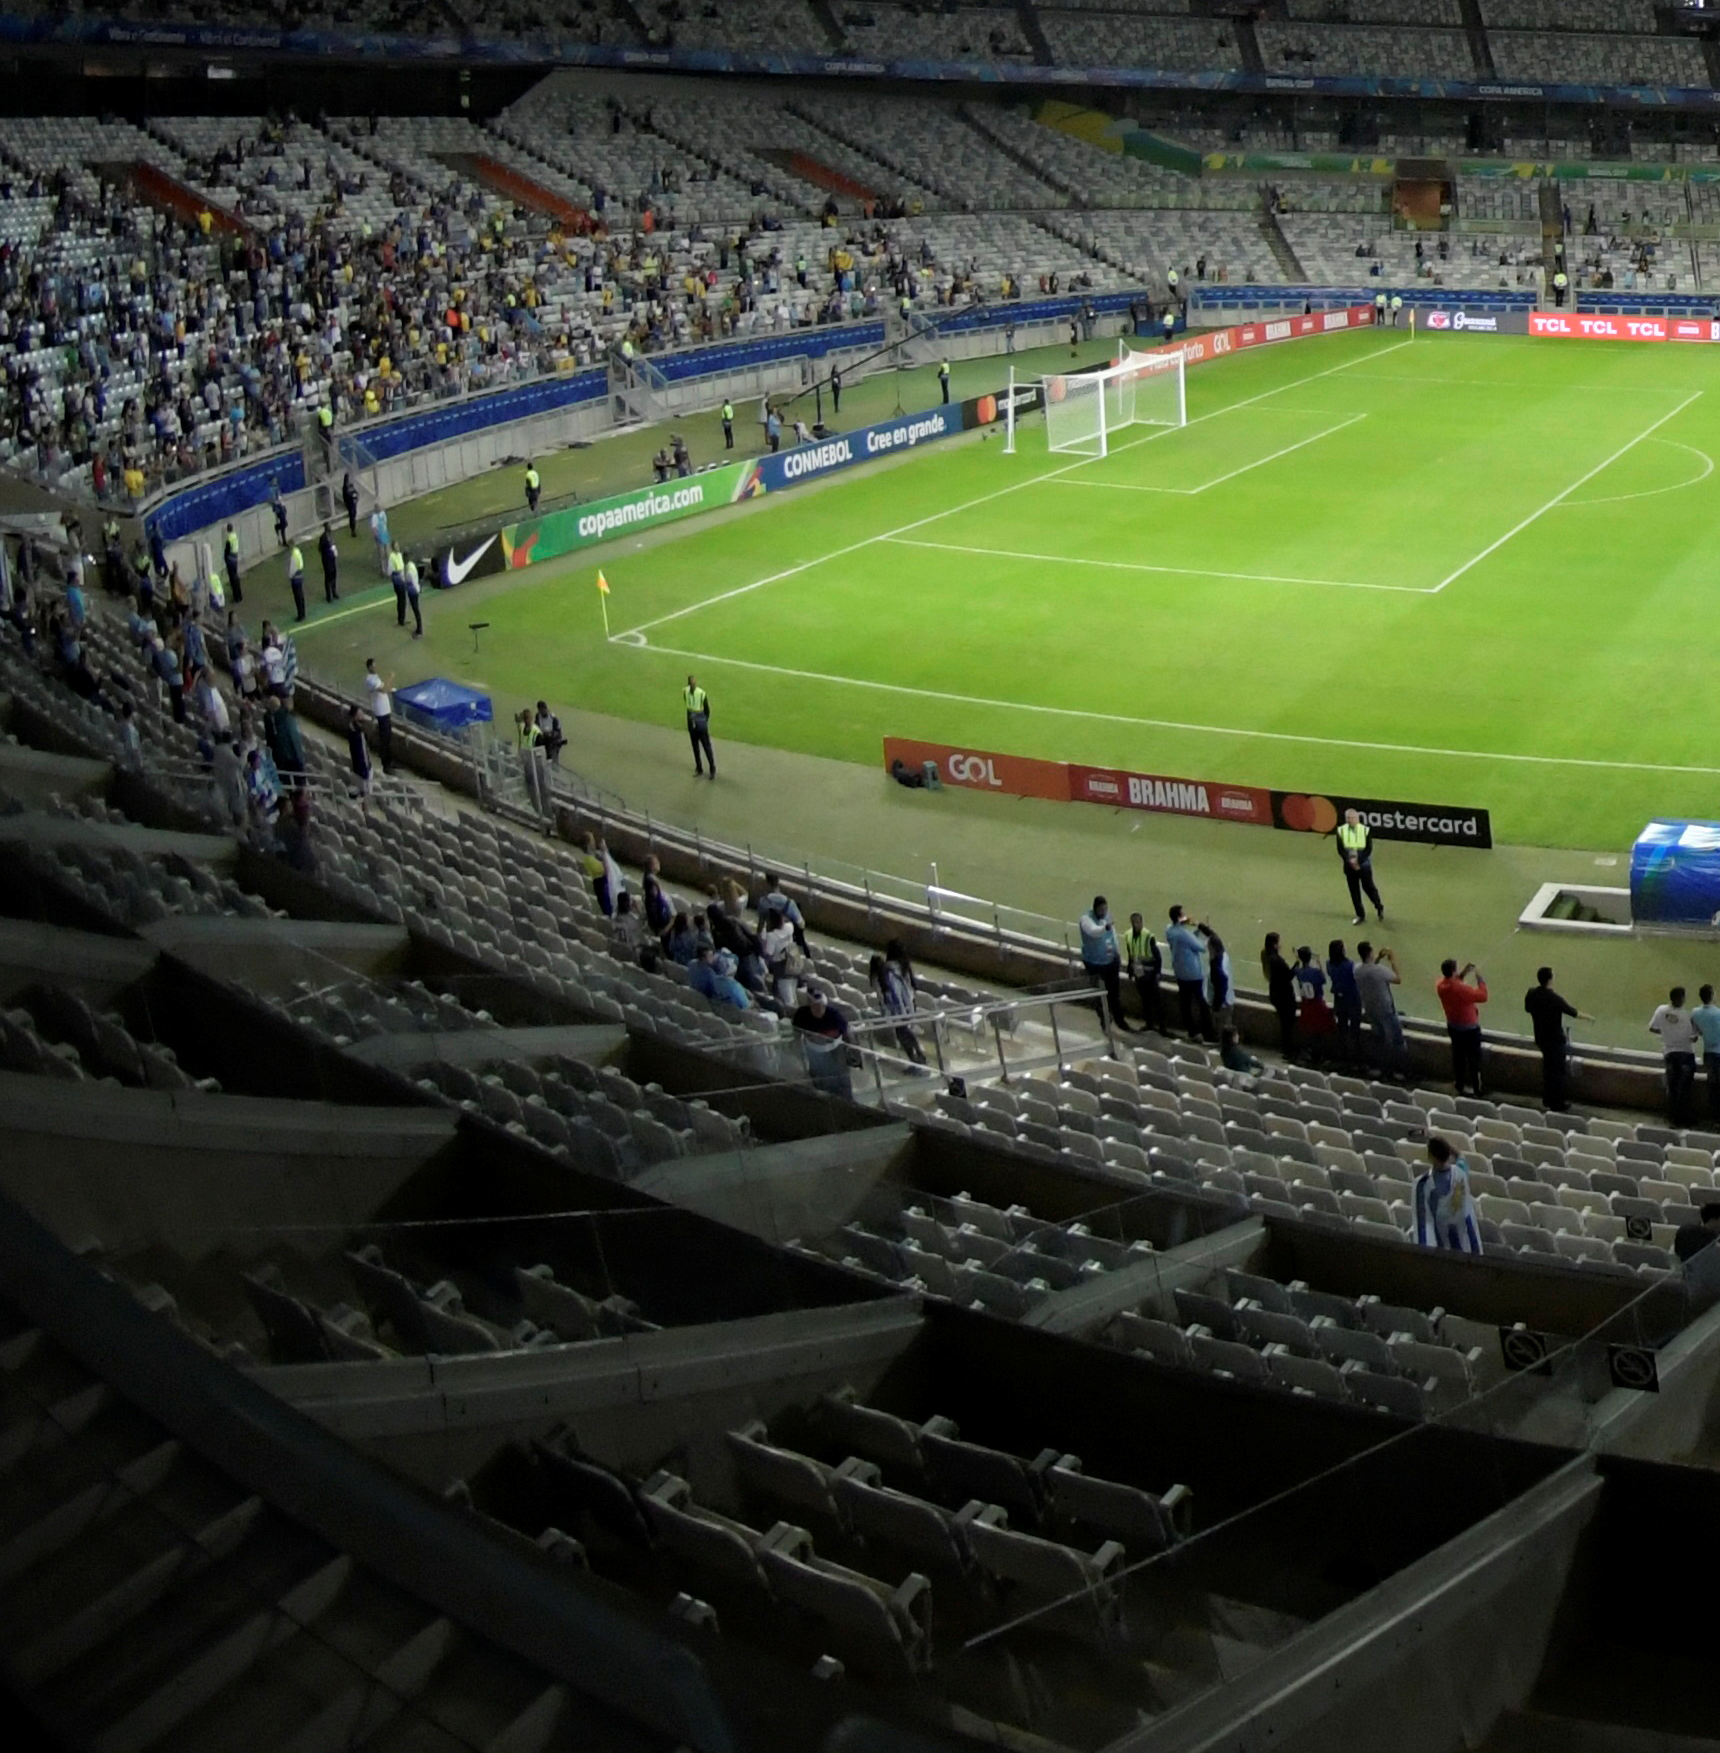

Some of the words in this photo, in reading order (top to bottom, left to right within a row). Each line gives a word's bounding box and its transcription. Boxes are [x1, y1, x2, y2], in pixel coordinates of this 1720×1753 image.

[1213, 332, 1232, 354] GOL
[1534, 318, 1571, 333] TCL
[1580, 321, 1617, 335] TCL
[1627, 323, 1665, 337] TCL
[867, 431, 893, 452] Cree
[893, 427, 908, 445] en
[784, 439, 853, 479] CONMEBOL
[578, 484, 704, 537] copaamerica.com
[948, 754, 1002, 787] GOL
[1128, 776, 1211, 813] BRAHMA
